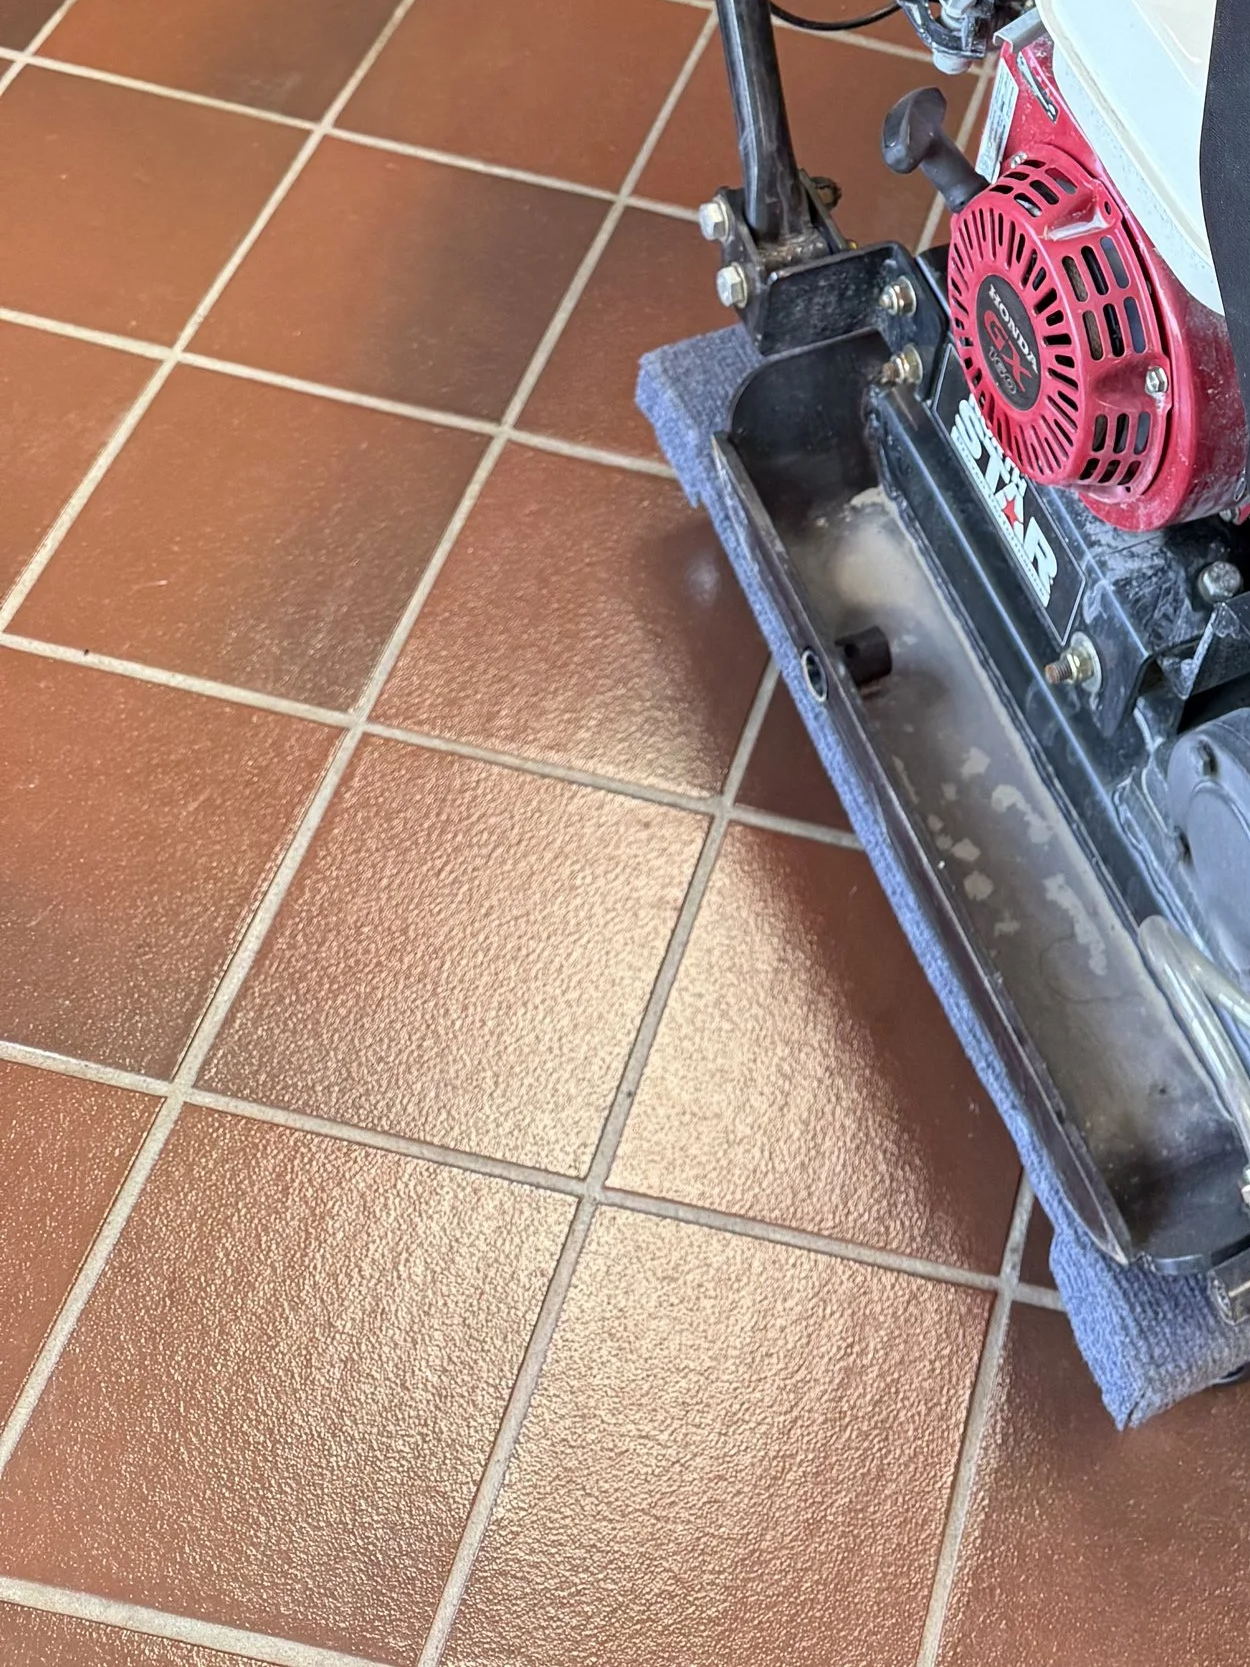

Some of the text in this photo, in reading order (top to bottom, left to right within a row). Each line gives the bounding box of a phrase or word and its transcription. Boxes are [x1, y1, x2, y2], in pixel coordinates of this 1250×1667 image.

[983, 309, 1033, 393] GX
[988, 283, 1039, 375] HONDA
[954, 398, 1058, 597] STAR
